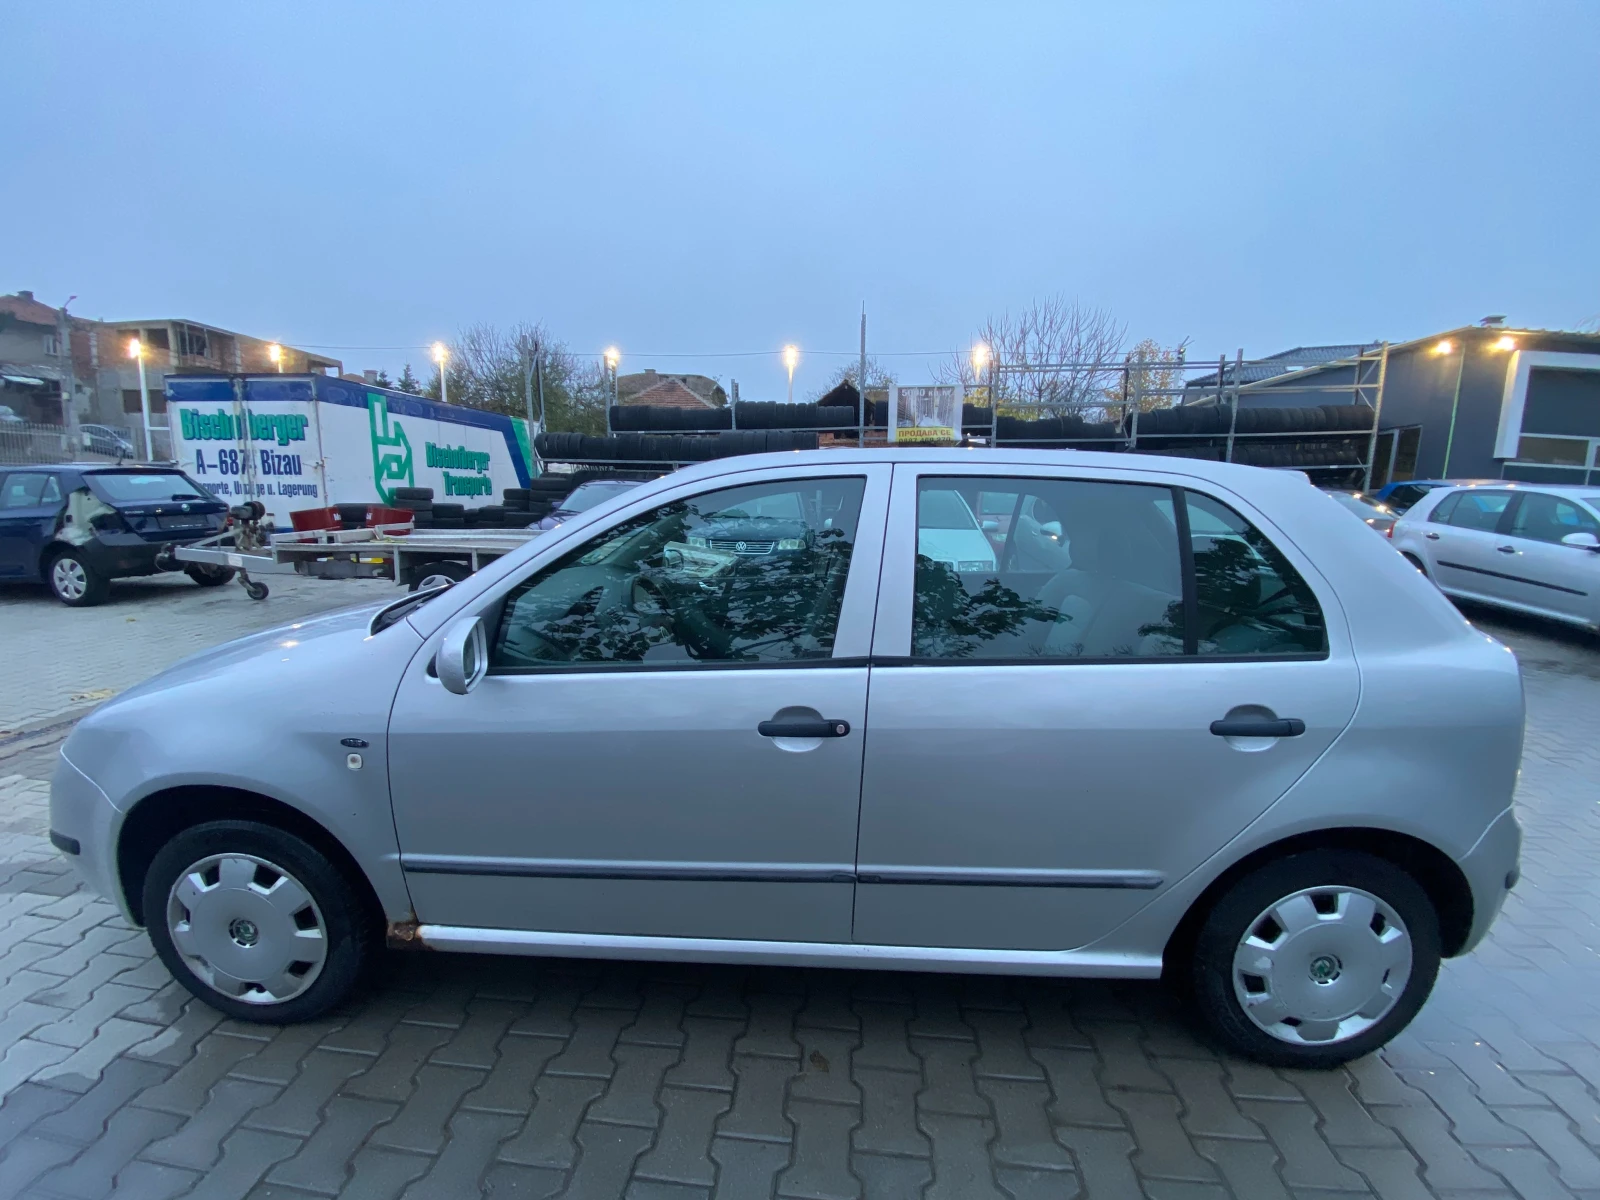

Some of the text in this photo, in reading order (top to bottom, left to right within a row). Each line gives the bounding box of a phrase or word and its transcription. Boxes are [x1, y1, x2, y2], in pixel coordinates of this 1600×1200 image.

[179, 408, 308, 446] Bischoberger
[898, 430, 938, 438] ПРОДАВА
[196, 448, 302, 475] A-687 Bizau
[425, 441, 490, 474] Bischofberger
[267, 484, 275, 496] u.
[278, 481, 318, 498] Lagerung
[442, 470, 492, 499] Transporte
